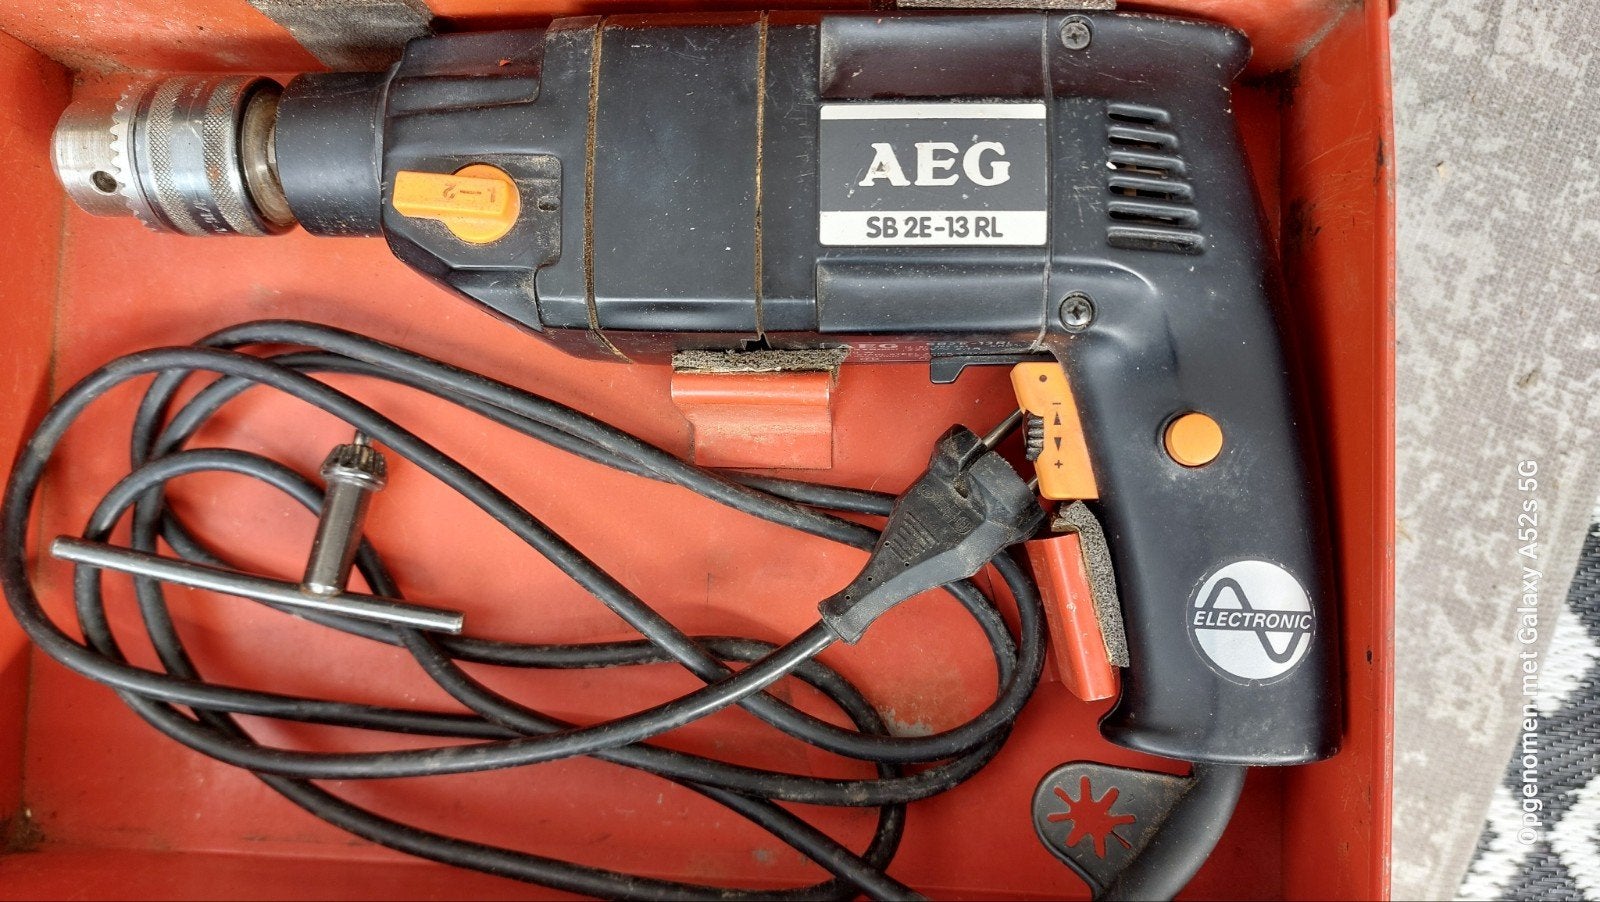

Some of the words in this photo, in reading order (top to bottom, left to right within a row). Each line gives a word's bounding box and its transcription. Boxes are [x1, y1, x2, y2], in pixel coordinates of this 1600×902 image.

[859, 141, 1011, 187] AEG
[866, 216, 898, 239] SB
[903, 216, 970, 239] 2E-13
[974, 216, 1003, 238] RL
[1193, 610, 1313, 630] ELECTRONIC
